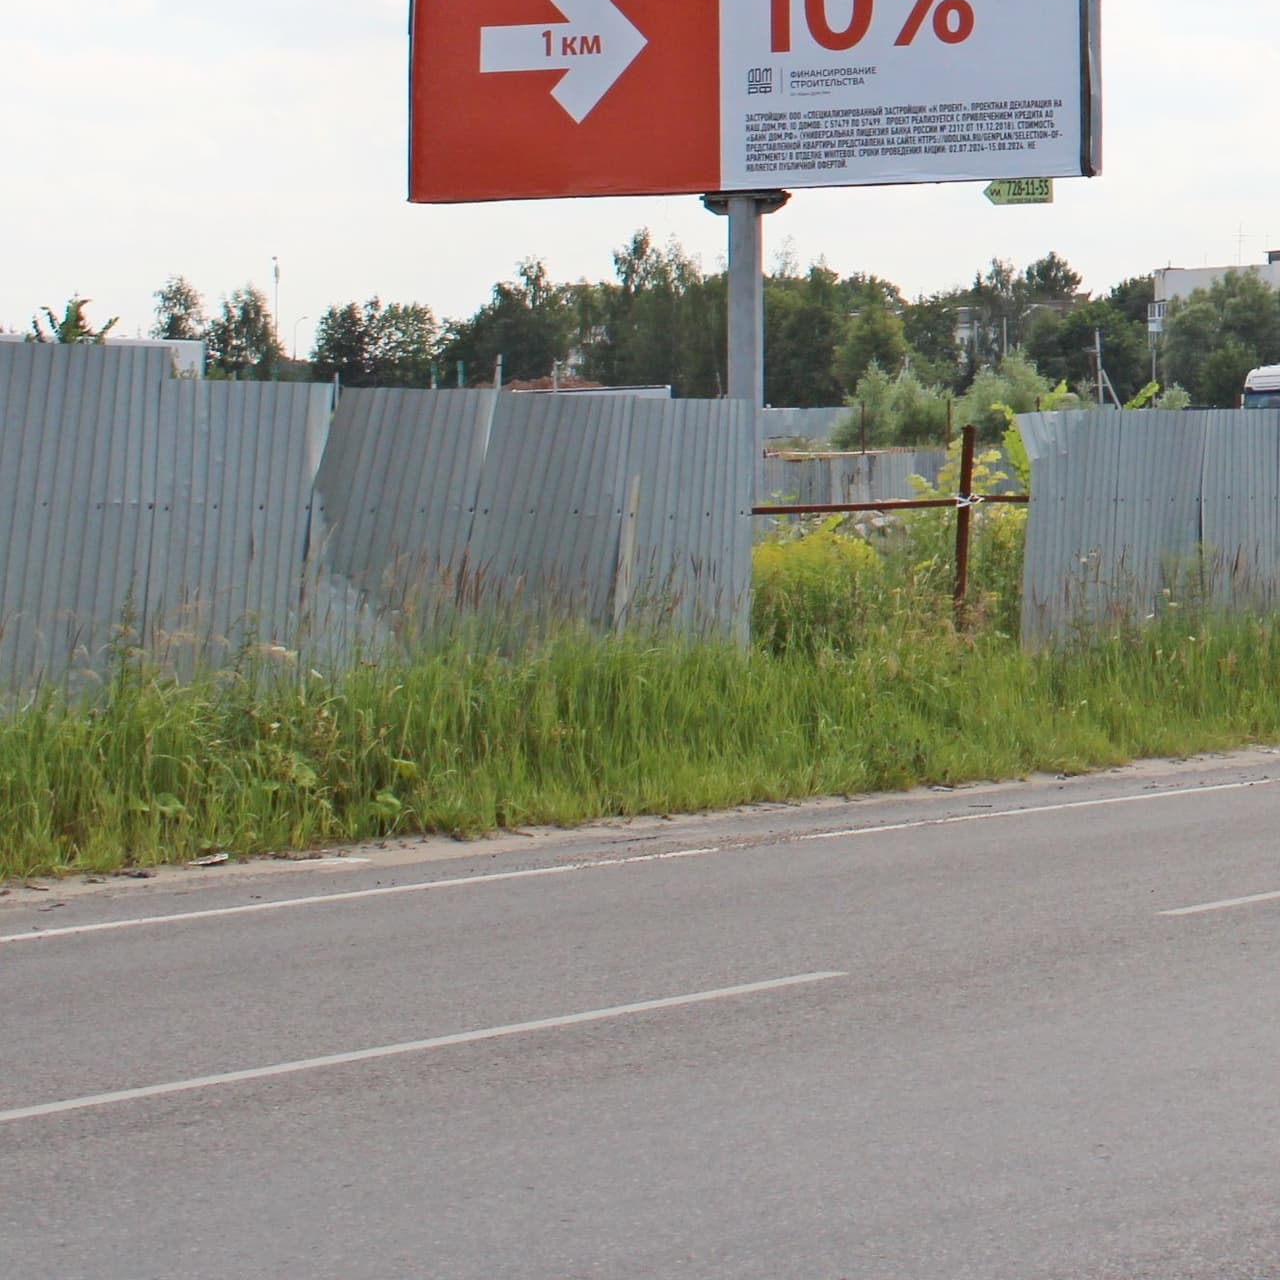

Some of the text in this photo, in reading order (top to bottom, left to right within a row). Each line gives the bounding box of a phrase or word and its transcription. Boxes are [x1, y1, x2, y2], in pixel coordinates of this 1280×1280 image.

[542, 30, 552, 57] 1
[790, 66, 877, 79] ФИНАНСИРОВАНИЕ
[790, 77, 866, 89] СТРОИТЕЛЬСТВА
